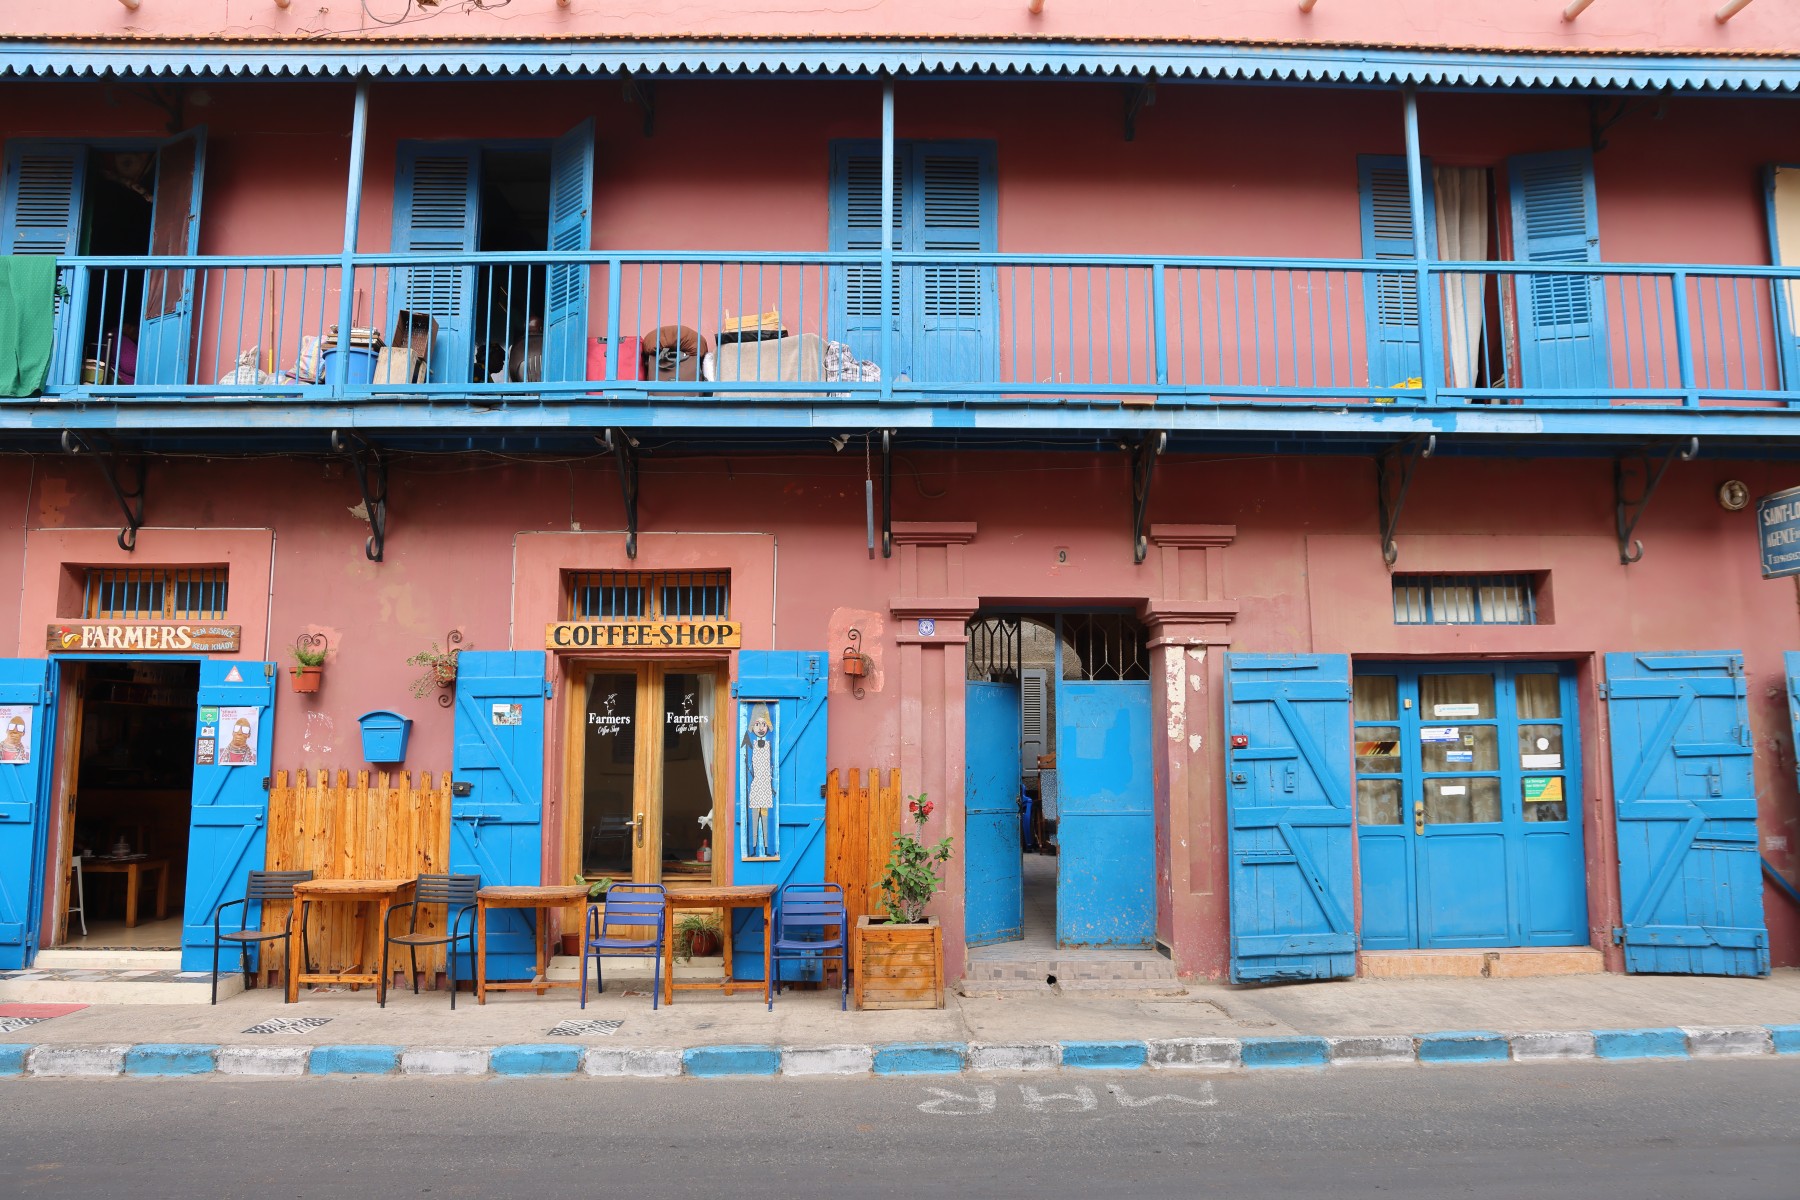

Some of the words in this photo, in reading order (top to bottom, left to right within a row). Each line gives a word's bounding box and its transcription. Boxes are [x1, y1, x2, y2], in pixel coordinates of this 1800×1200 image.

[1767, 528, 1796, 547] AGENCE
[1059, 550, 1066, 563] 9
[81, 625, 192, 649] FARMERS
[553, 624, 733, 646] COFFEE-SHOP
[191, 642, 209, 651] KEUR
[211, 641, 234, 651] KHADY
[588, 712, 631, 724] Farmers
[666, 712, 709, 724] Farmers
[610, 724, 620, 736] Shop
[688, 723, 698, 736] Shop
